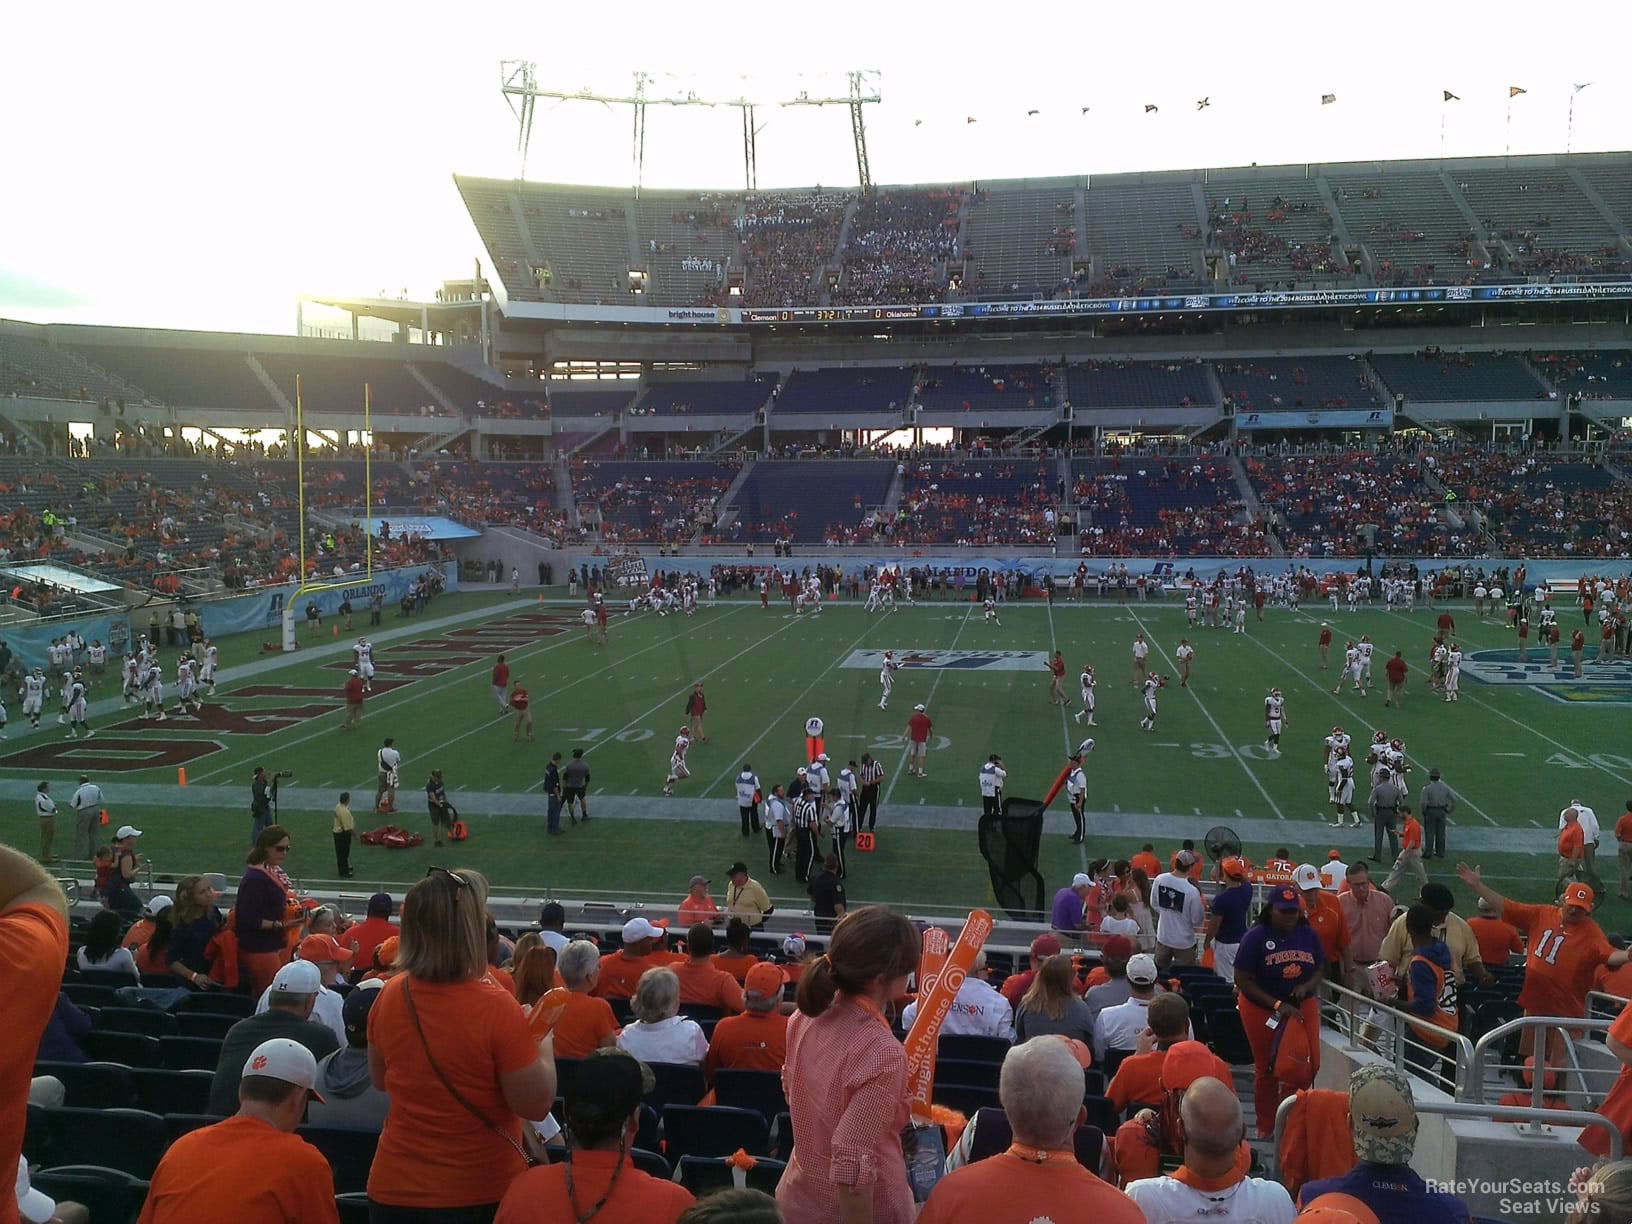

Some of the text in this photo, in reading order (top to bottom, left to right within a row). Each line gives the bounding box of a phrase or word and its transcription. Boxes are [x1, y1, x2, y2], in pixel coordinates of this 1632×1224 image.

[668, 310, 692, 319] bright
[750, 313, 777, 321] Clemson
[782, 311, 788, 320] 0
[875, 308, 882, 319] 0
[909, 566, 990, 578] OLANDO
[342, 583, 386, 600] ORLANDO
[568, 727, 655, 743] 10
[1189, 742, 1282, 760] 30
[857, 834, 872, 848] 20
[1273, 862, 1291, 872] 75
[1534, 929, 1565, 965] 11
[919, 998, 950, 1047] house
